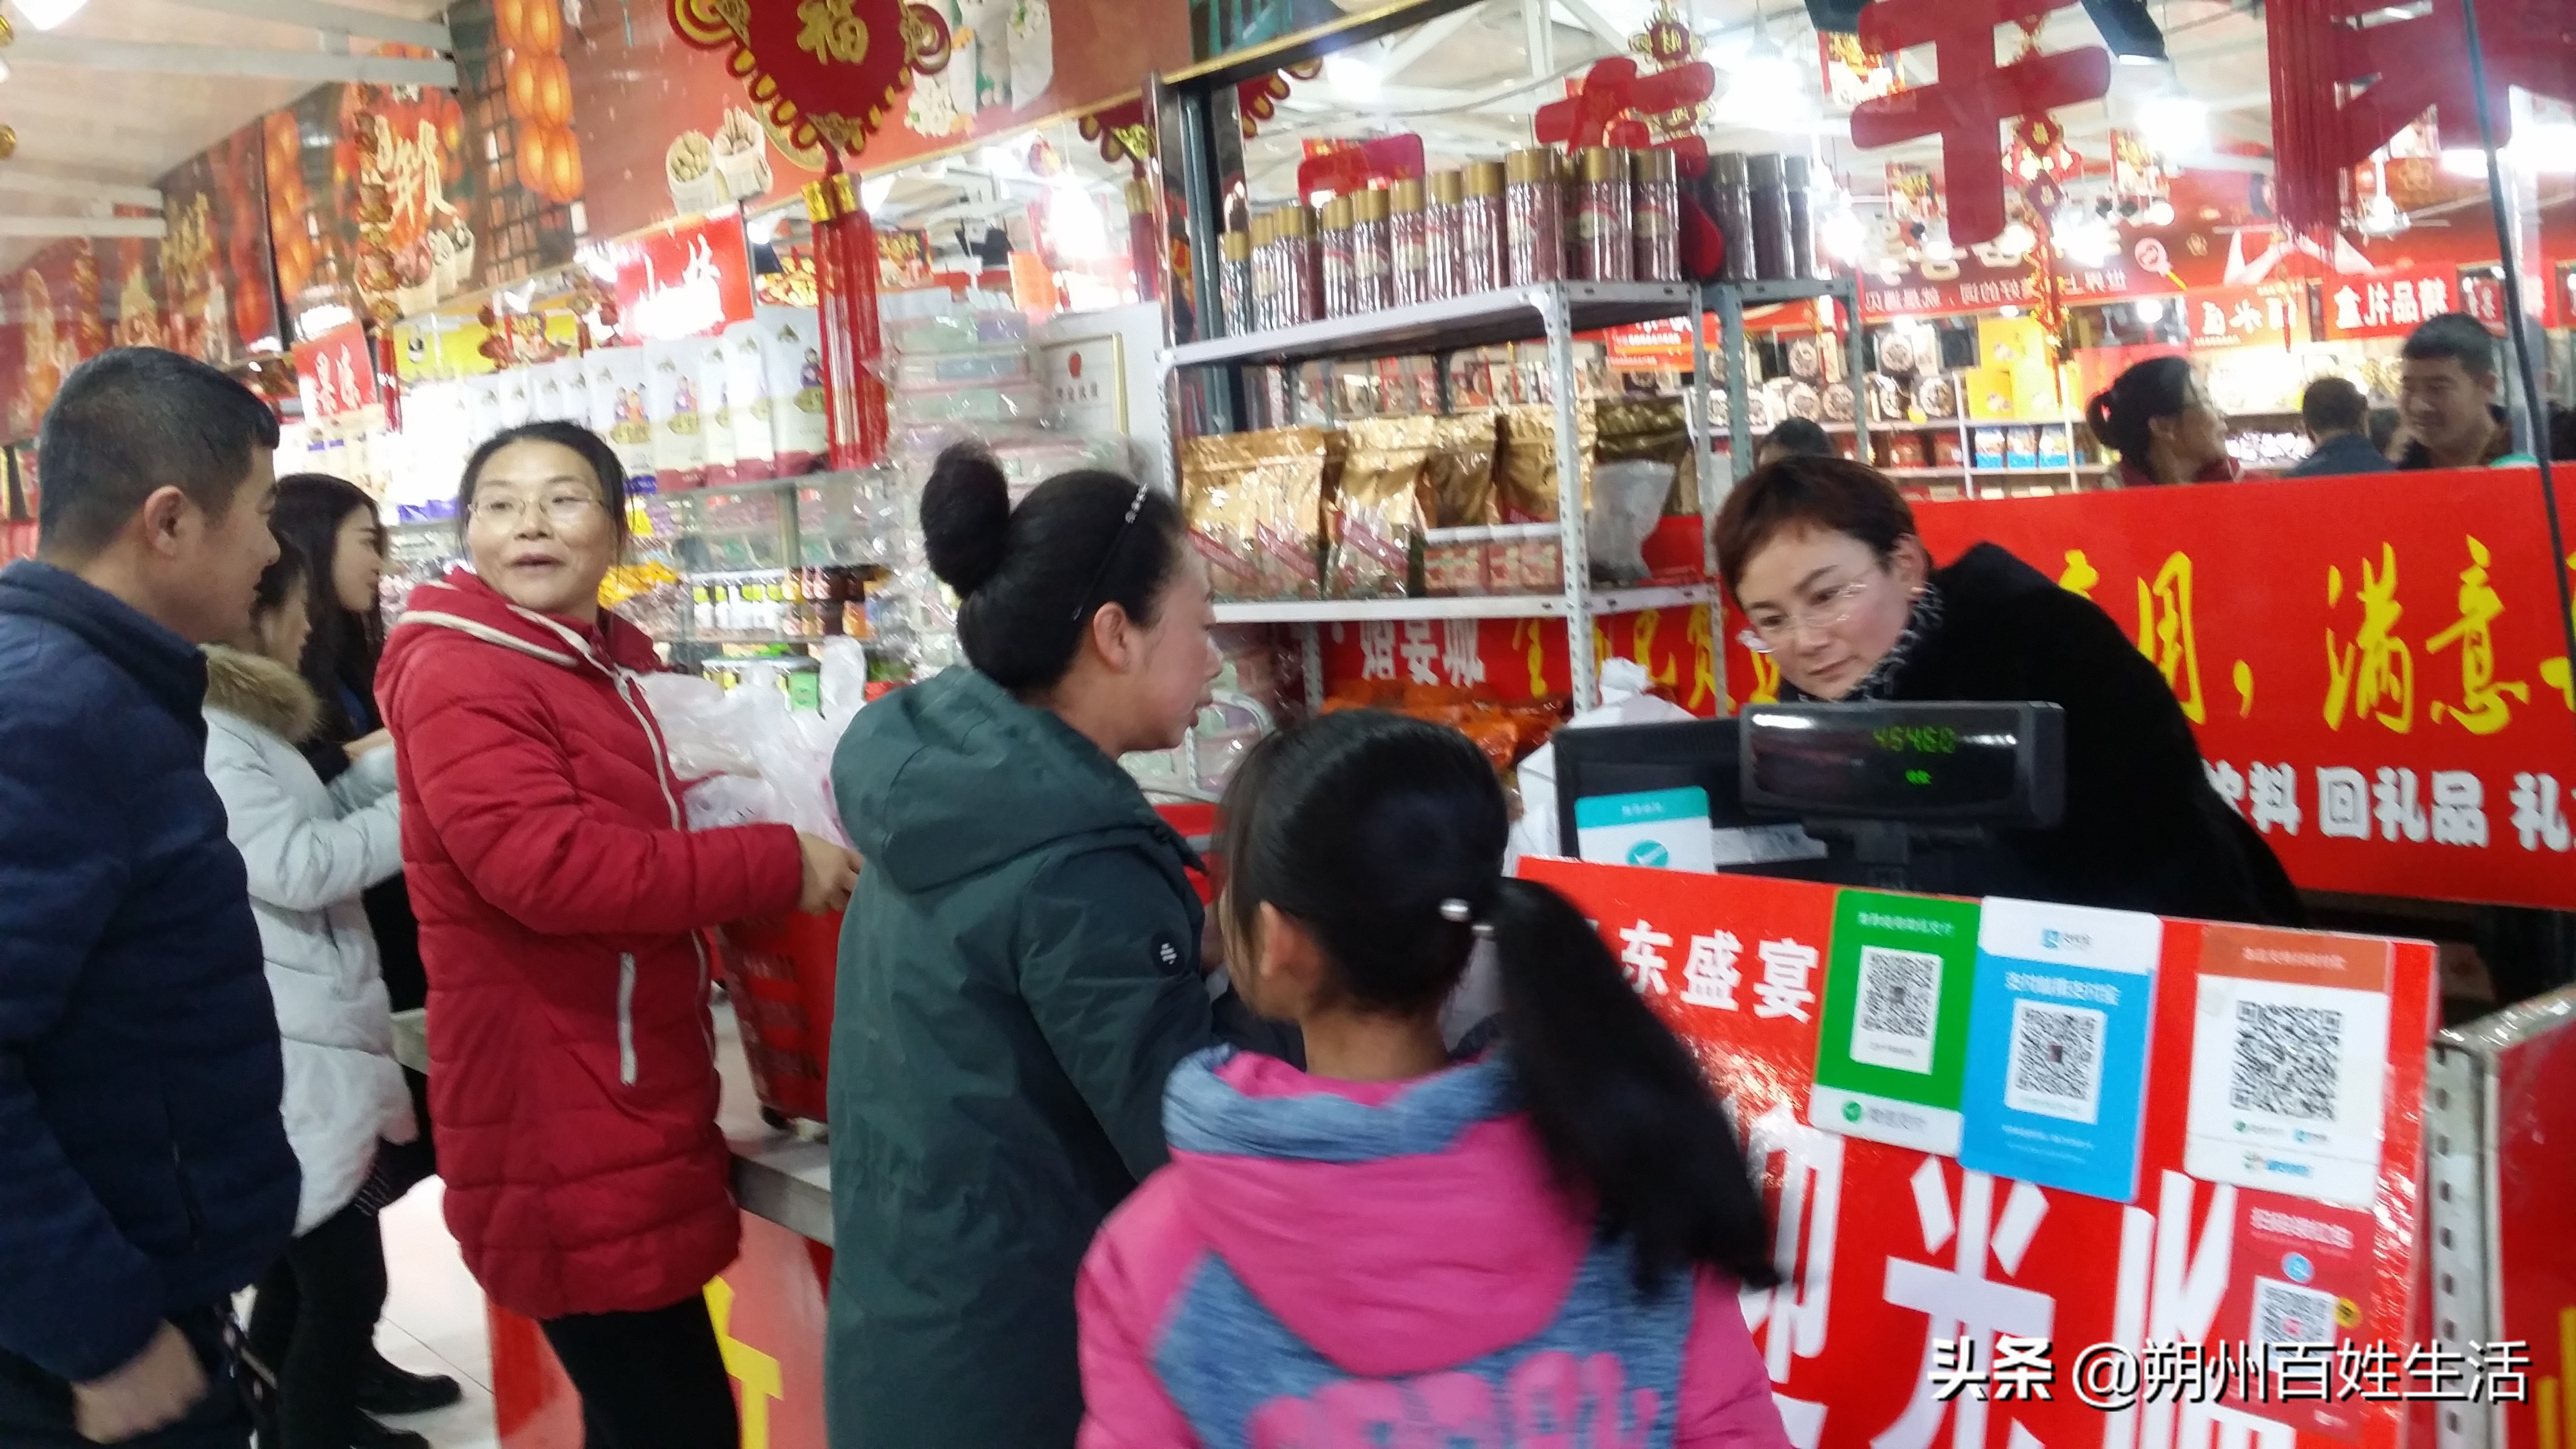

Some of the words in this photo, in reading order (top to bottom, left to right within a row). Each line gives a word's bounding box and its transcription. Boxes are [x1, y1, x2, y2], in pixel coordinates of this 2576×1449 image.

[797, 0, 869, 65] 福
[2316, 766, 2490, 849] 回礼品
[2509, 771, 2576, 852] 礼
[1587, 917, 1820, 1023] 东盛宴
